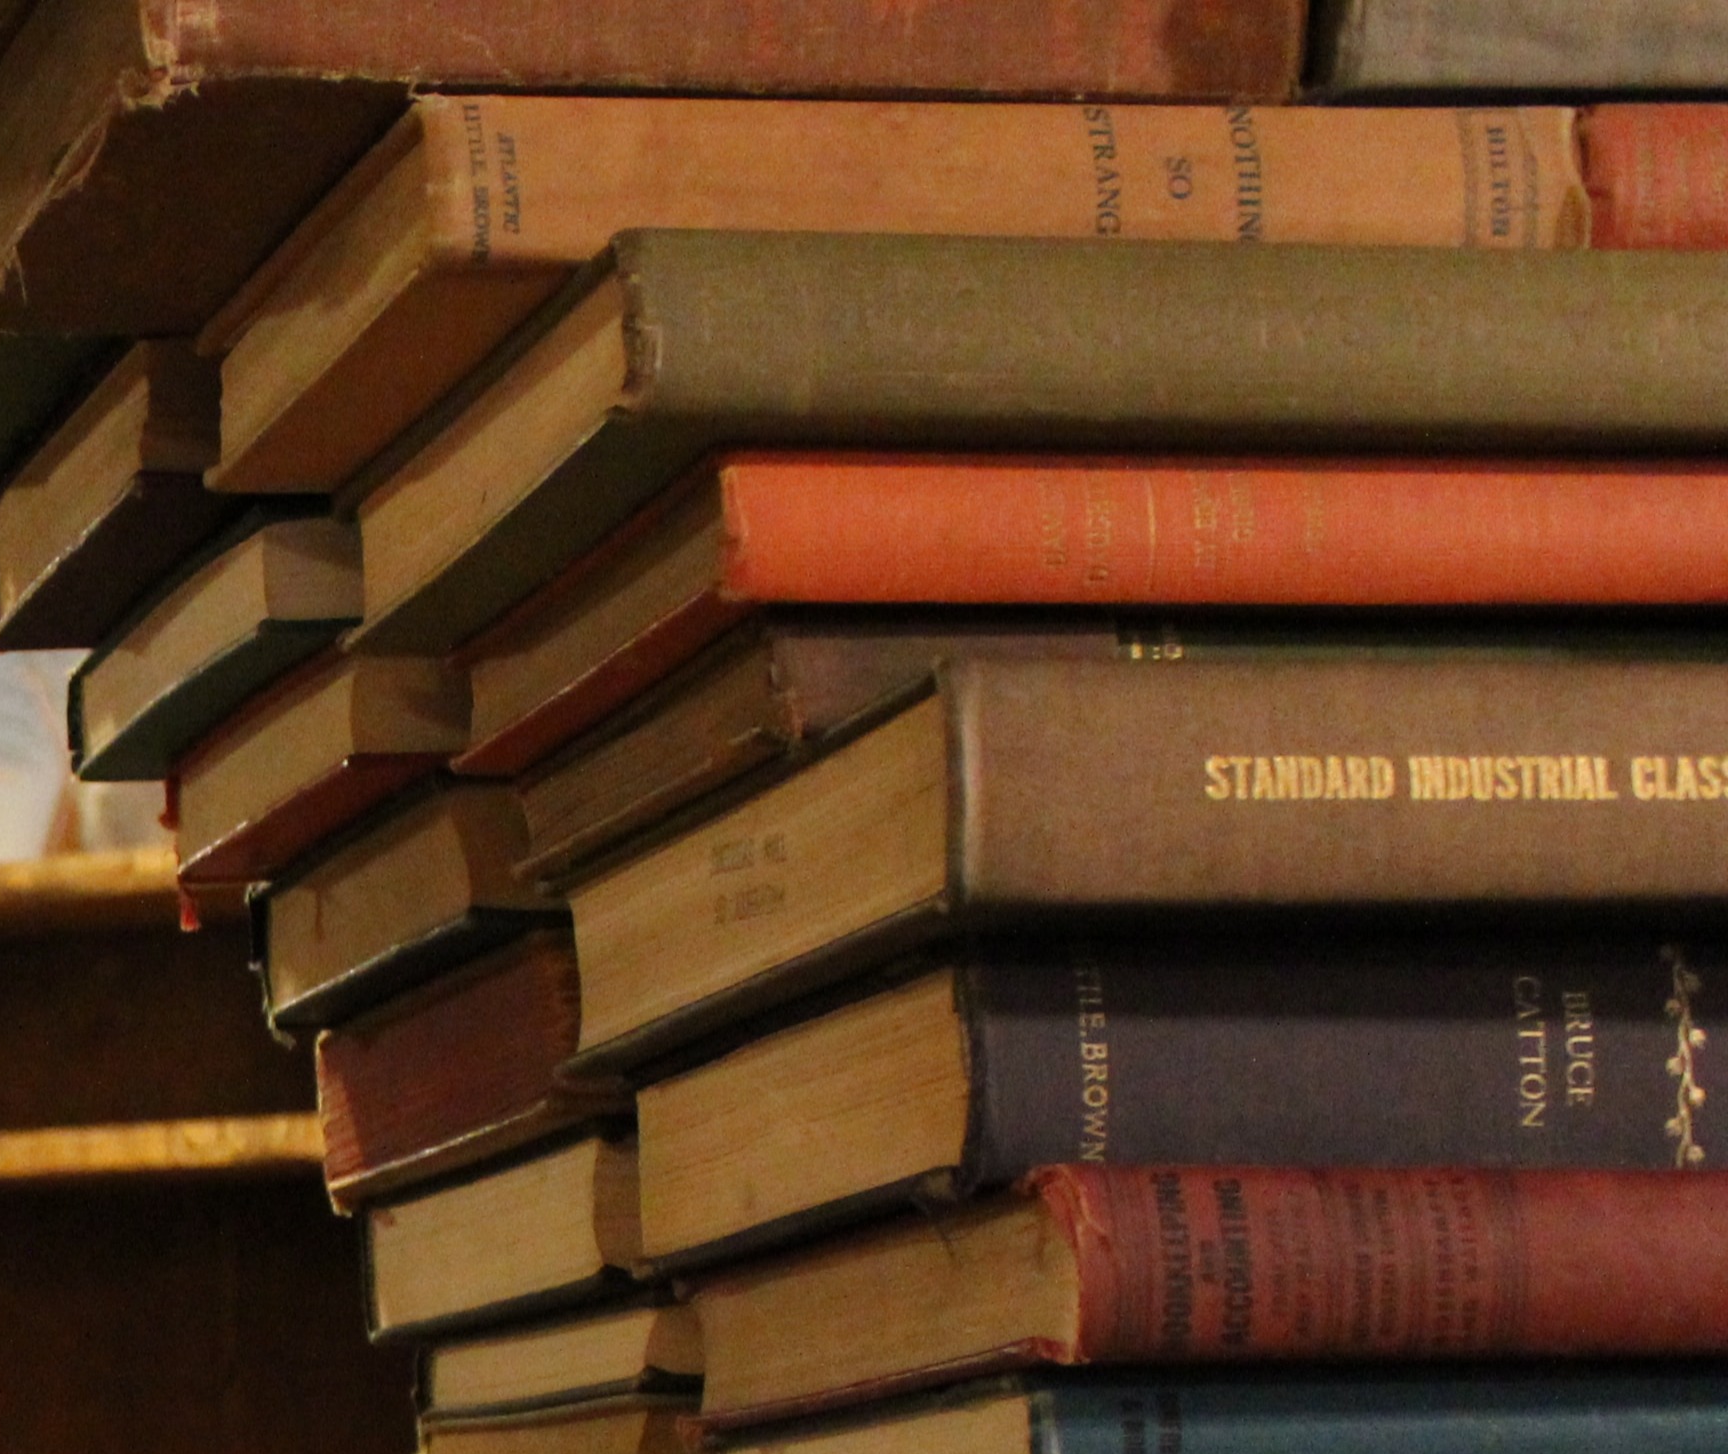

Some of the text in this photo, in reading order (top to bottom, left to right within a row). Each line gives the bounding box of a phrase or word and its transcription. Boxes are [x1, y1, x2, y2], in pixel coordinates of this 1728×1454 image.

[1082, 106, 1122, 236] STRANG
[1164, 156, 1194, 200] SO
[1204, 755, 1395, 800] STANDARD
[1408, 755, 1619, 800] INDUSTRIAL
[1077, 1041, 1110, 1163] BROWN
[1511, 973, 1547, 1130] CATTON
[1563, 989, 1595, 1109] BRUCE
